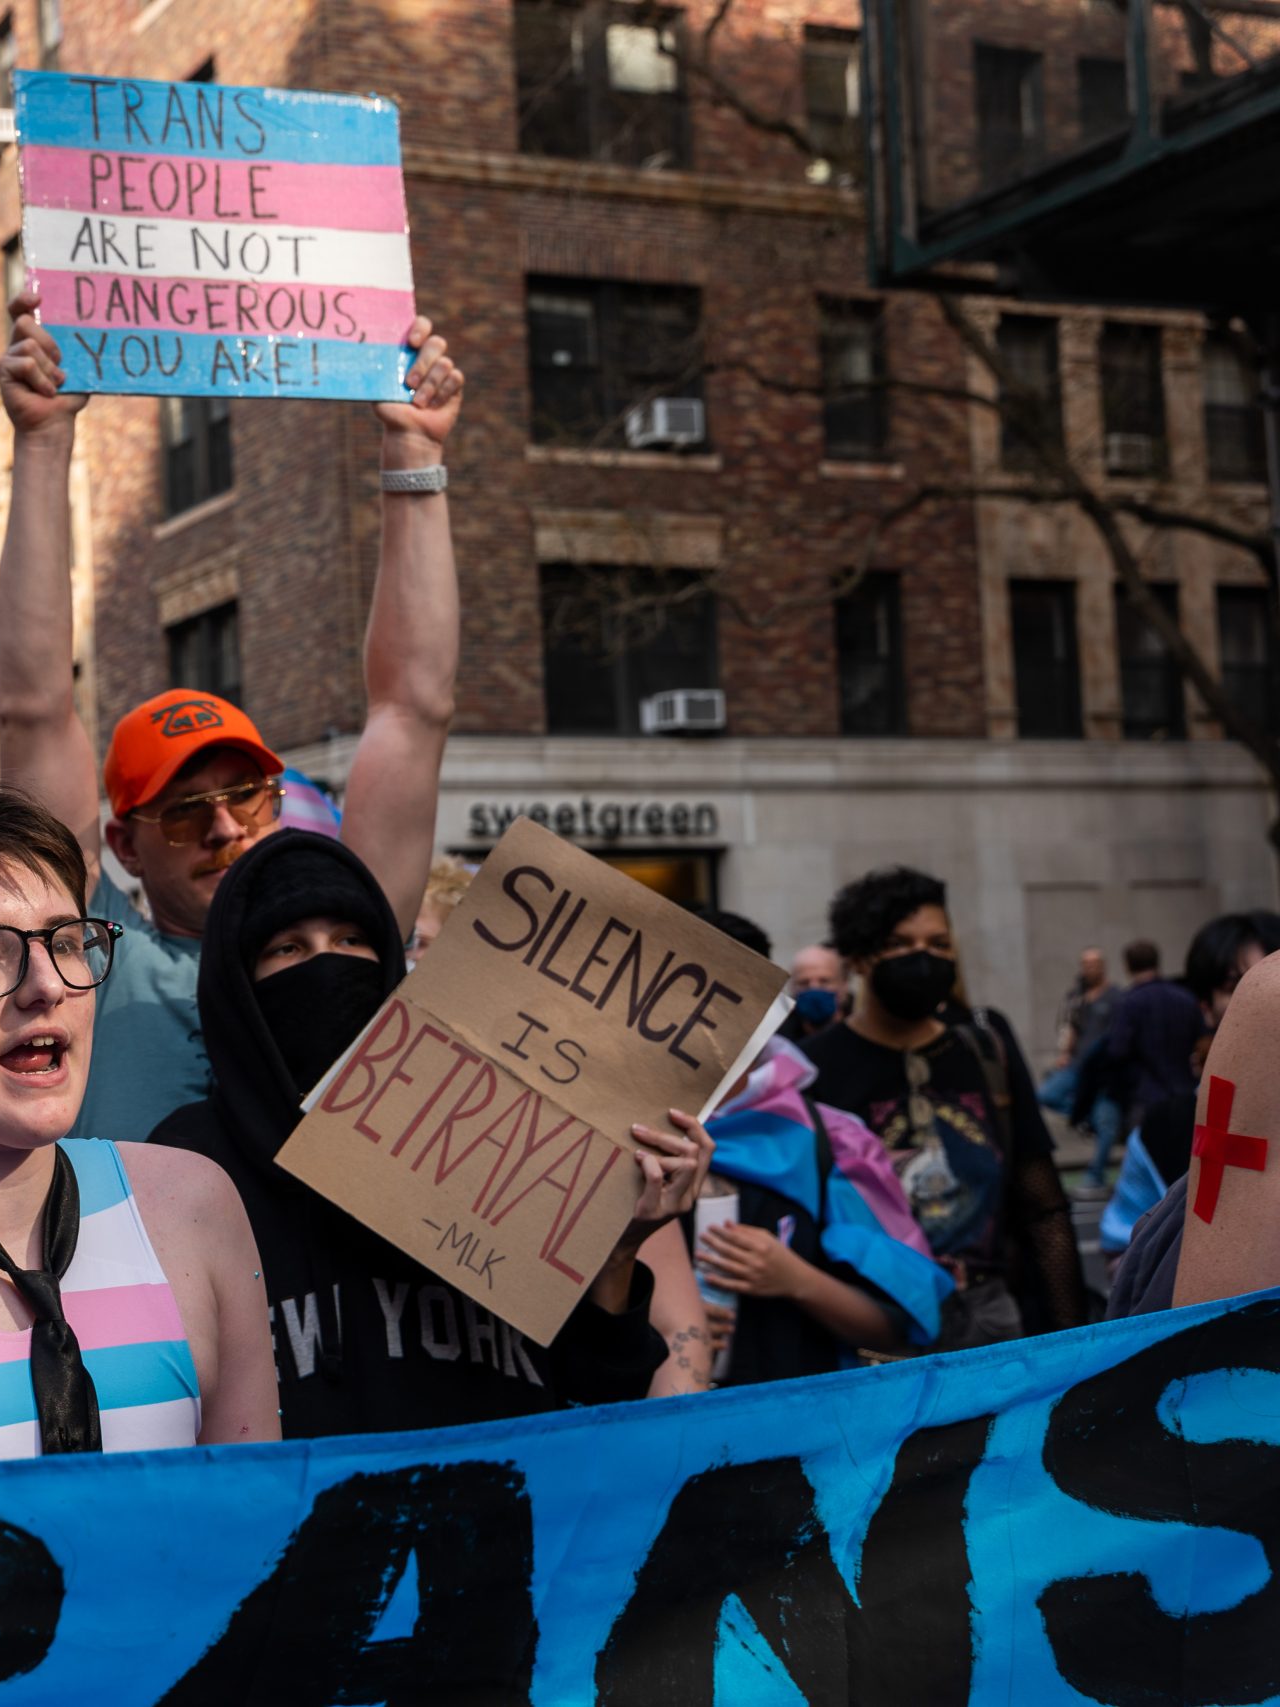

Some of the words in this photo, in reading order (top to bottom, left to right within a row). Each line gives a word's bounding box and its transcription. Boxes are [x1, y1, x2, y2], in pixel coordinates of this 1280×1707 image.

[70, 78, 266, 154] TRANS
[90, 153, 279, 219] PEOPLE
[70, 217, 158, 269] ARE
[190, 227, 316, 276] NOT
[74, 276, 366, 343] DANGEROUS,
[74, 332, 184, 380] YOU
[210, 340, 320, 387] ARE!
[469, 796, 719, 838] sweetgreen
[472, 866, 742, 1070] SILENCE
[500, 1012, 588, 1084] IS
[321, 999, 622, 1285] BETRAYAL
[372, 1277, 544, 1386] YORK
